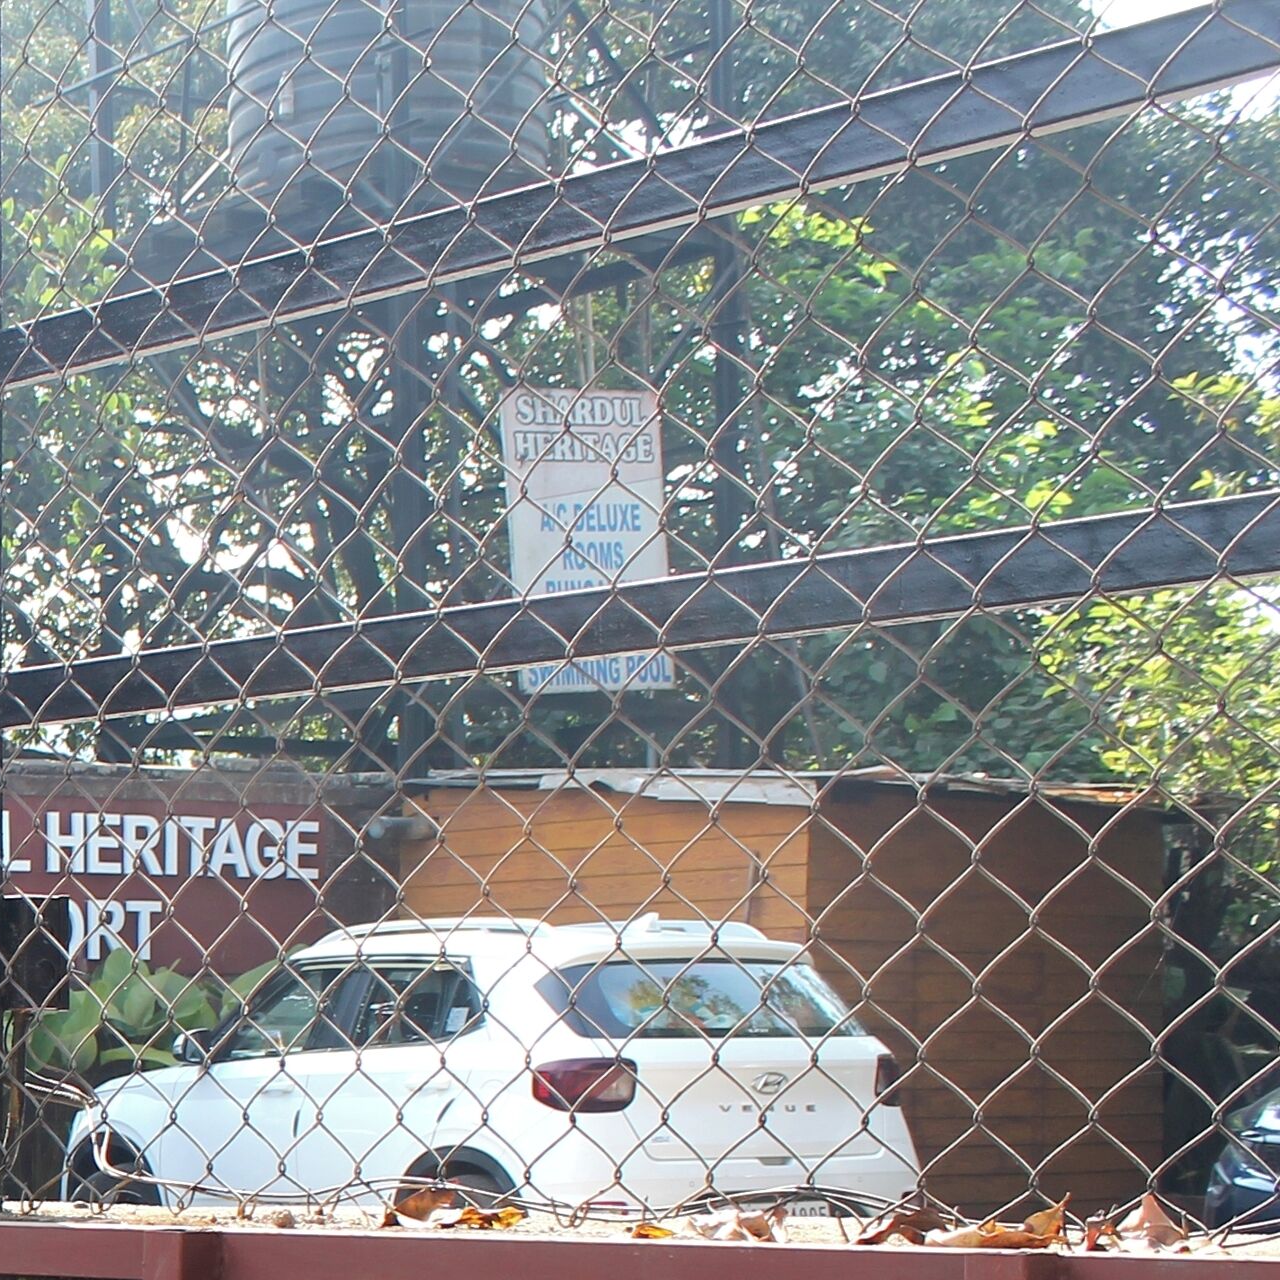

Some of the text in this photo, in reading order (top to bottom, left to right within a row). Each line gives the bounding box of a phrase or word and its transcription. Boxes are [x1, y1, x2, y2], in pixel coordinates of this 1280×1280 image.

[516, 394, 647, 427] SHARDUL
[514, 430, 655, 463] HERITAGE
[574, 503, 641, 532] DELUXE
[563, 541, 624, 570] ROOMS
[626, 654, 671, 683] POOL
[45, 811, 320, 880] HERITAGE
